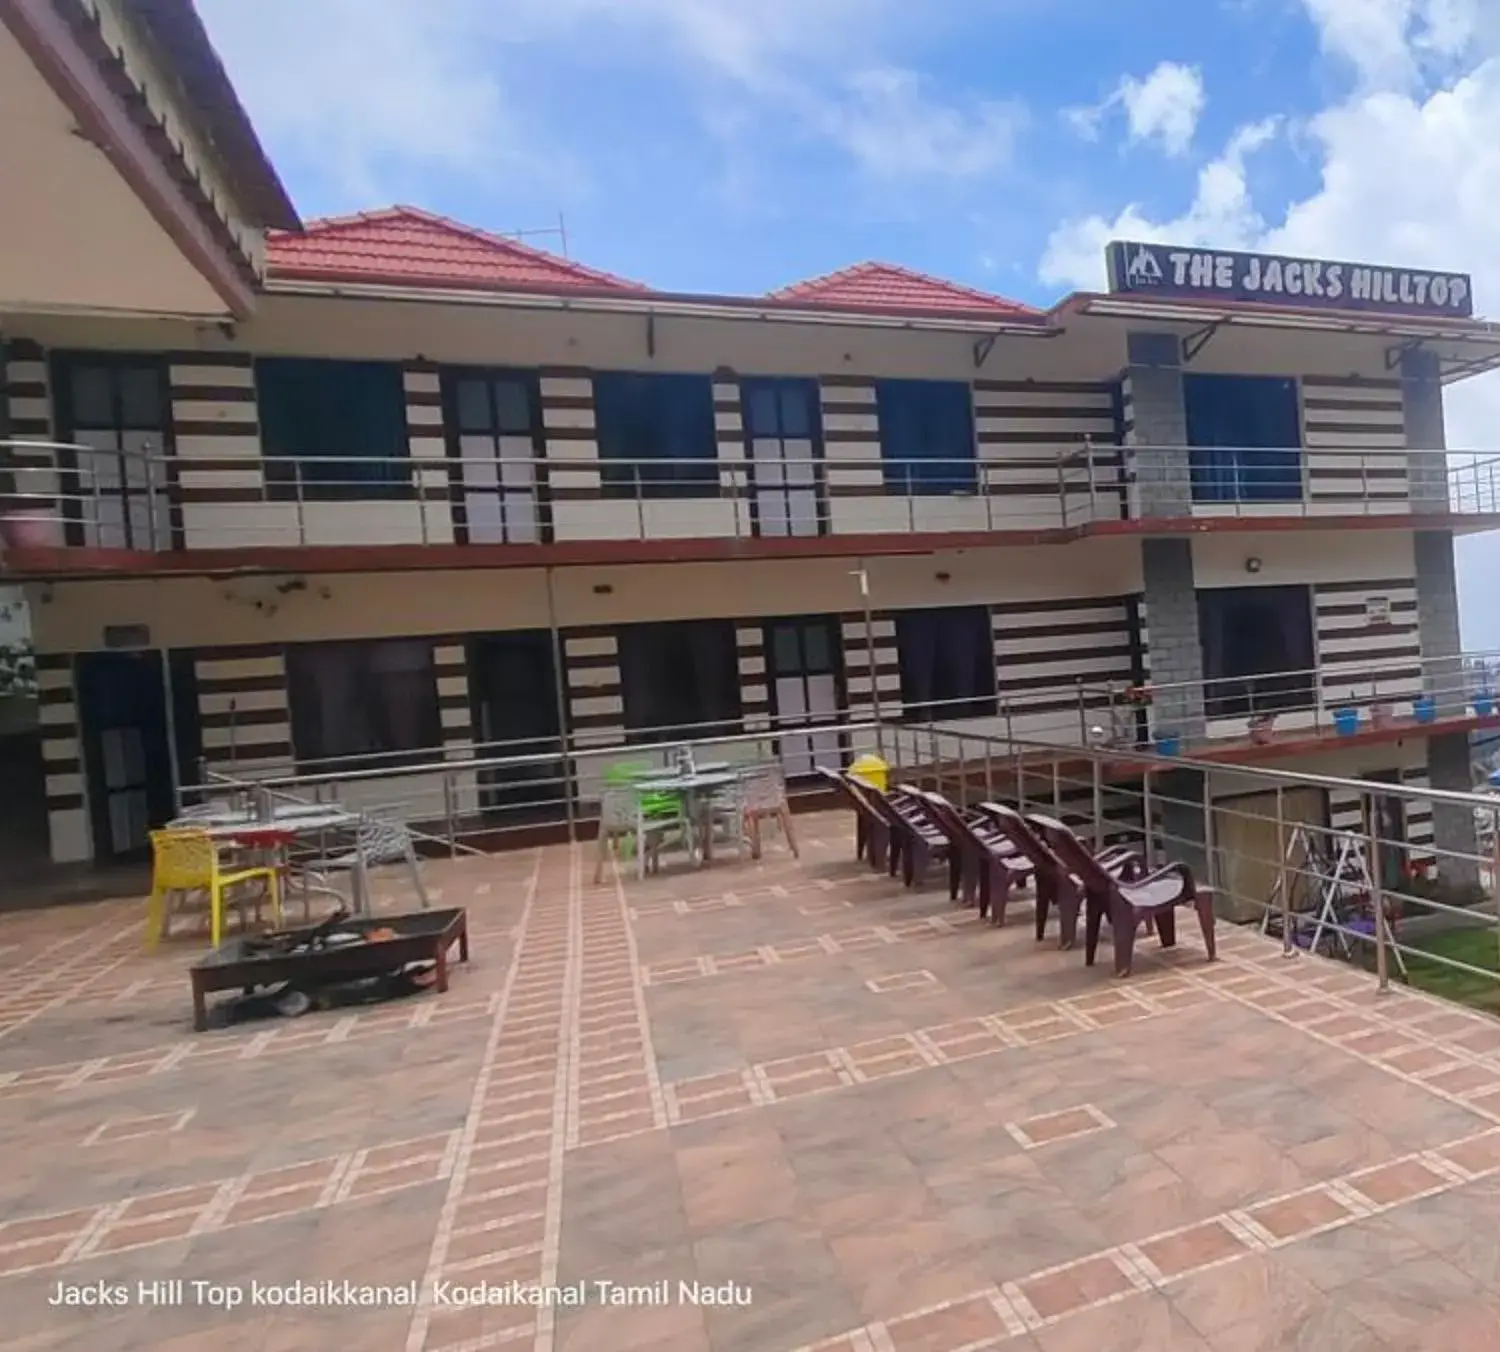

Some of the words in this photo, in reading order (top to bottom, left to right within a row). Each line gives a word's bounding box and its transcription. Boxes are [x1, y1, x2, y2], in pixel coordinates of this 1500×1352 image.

[1170, 253, 1234, 289] THE
[1243, 257, 1343, 298] JACKS
[1350, 267, 1467, 308] HILLTOP
